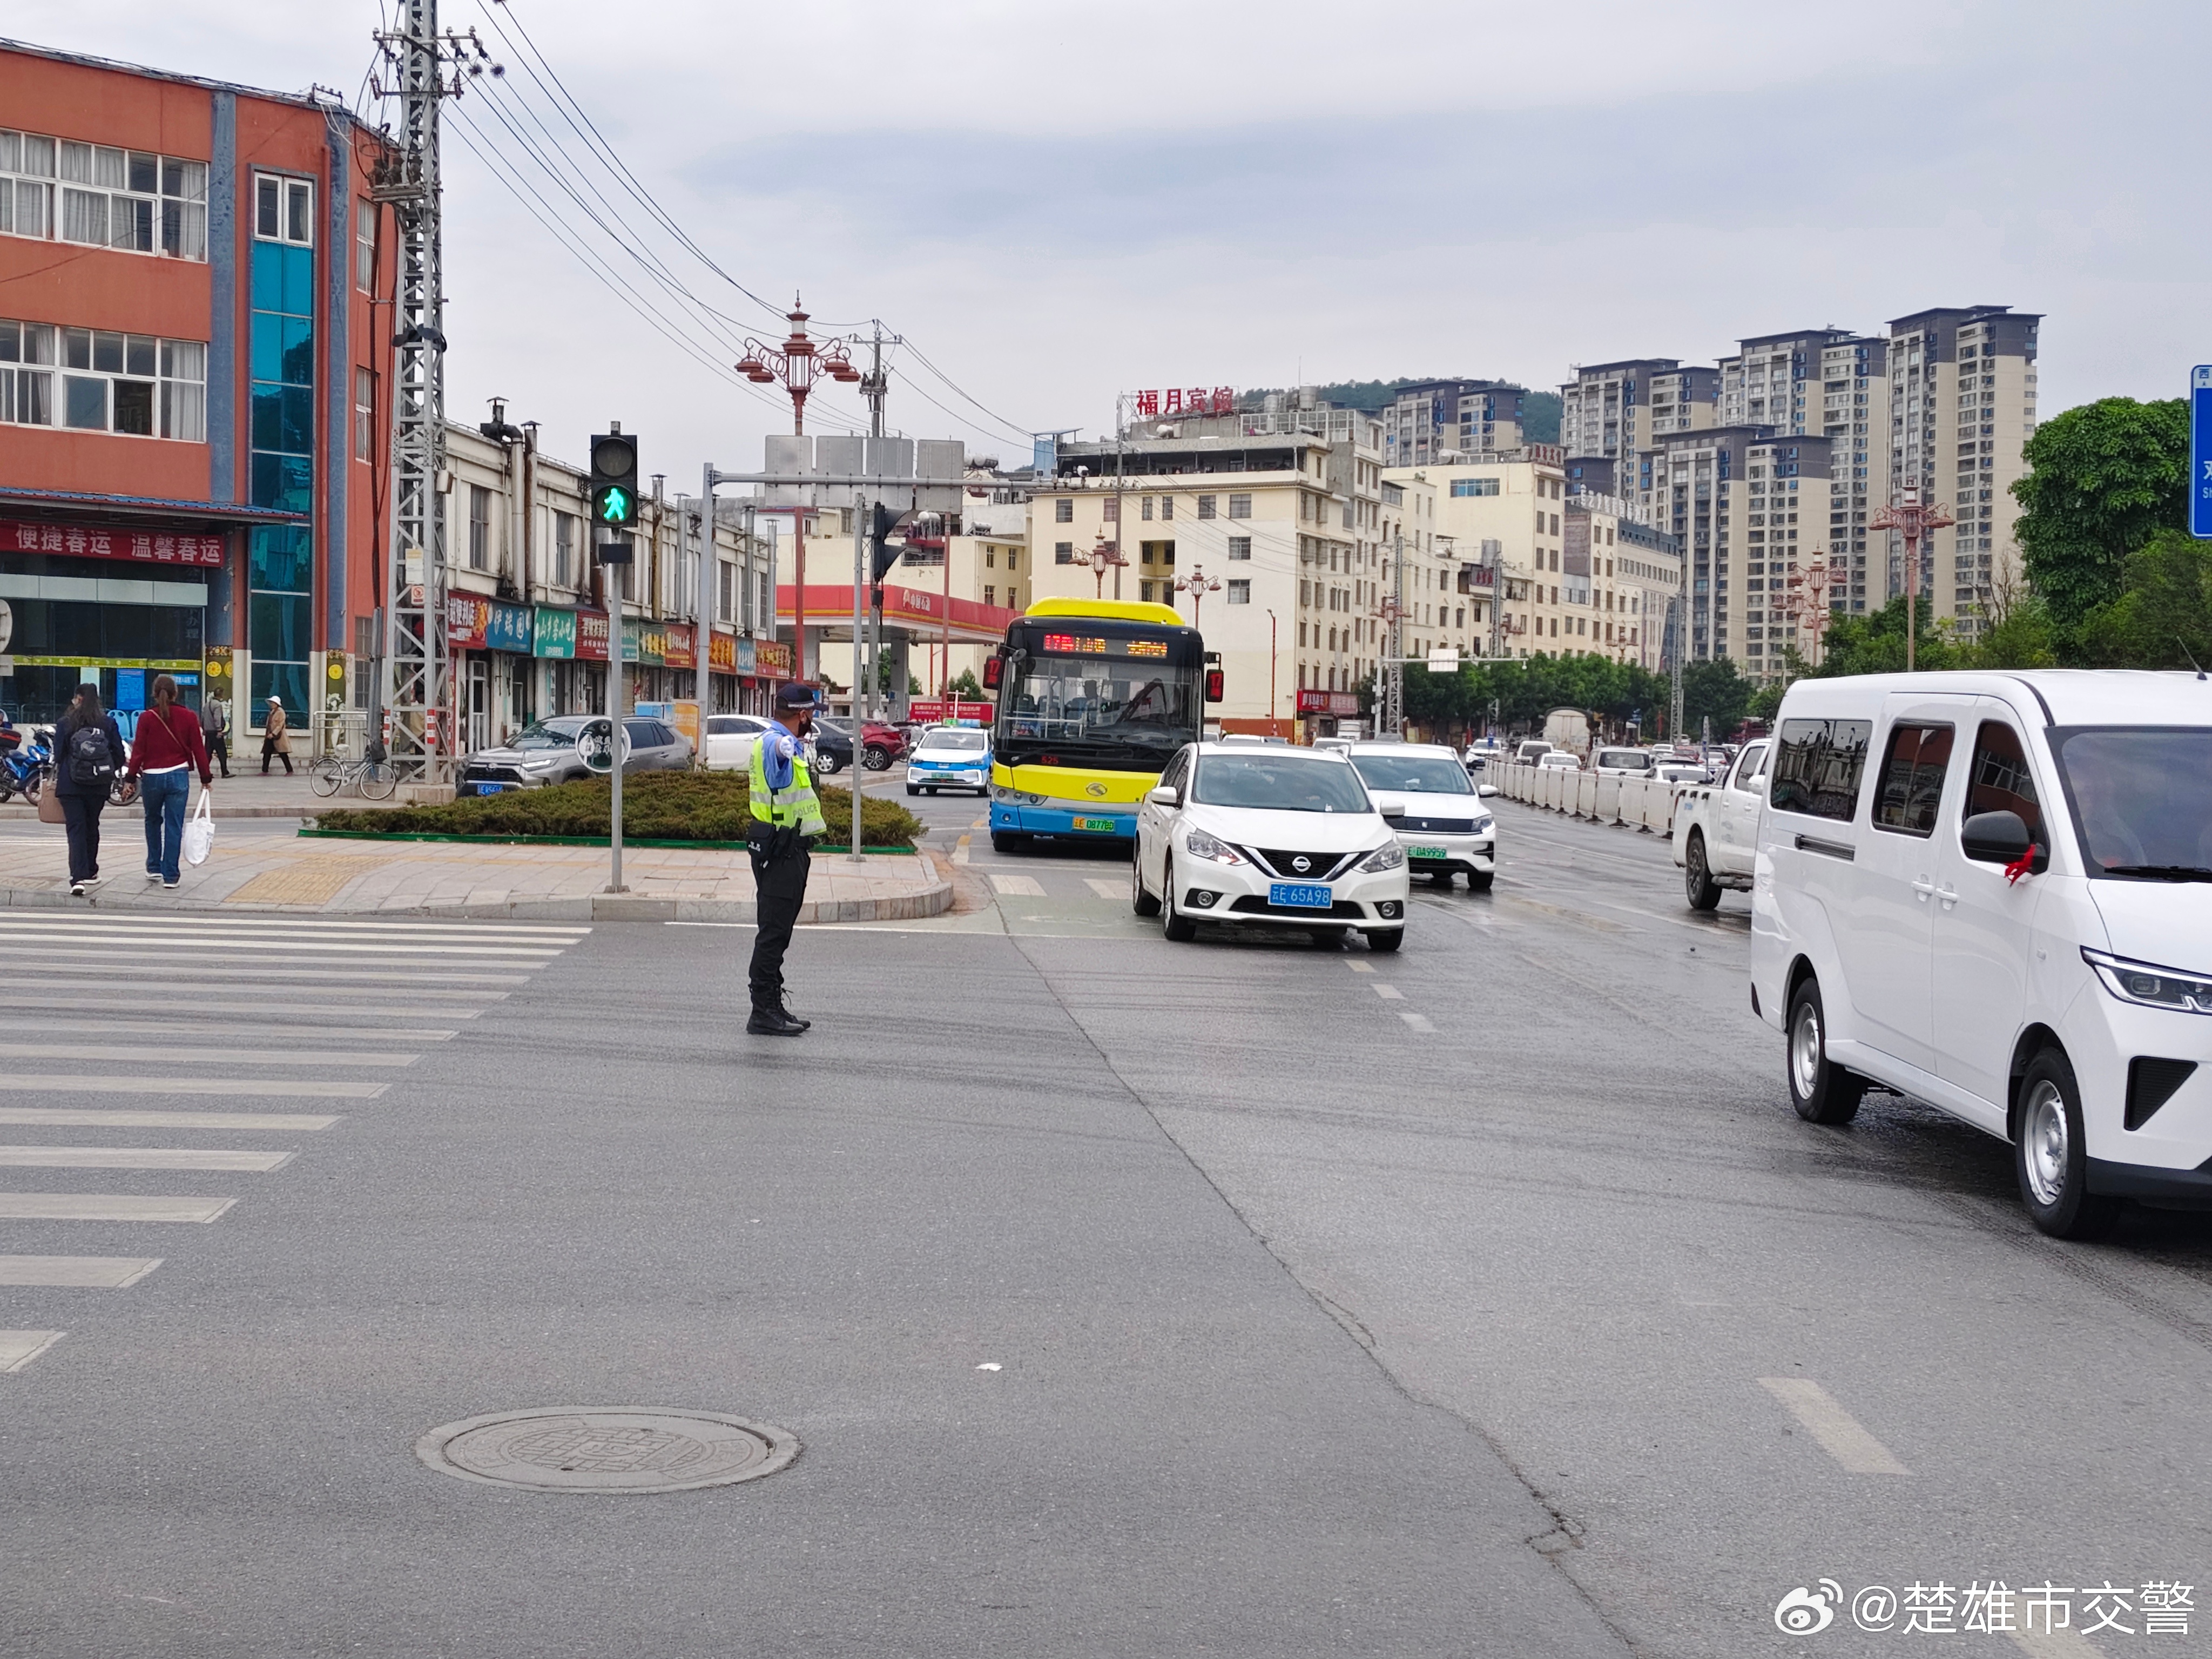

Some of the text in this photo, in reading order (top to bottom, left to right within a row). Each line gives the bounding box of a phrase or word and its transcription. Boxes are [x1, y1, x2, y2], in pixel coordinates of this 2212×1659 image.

[2199, 368, 2209, 379] 西
[1136, 386, 1233, 415] 福月宾馆
[16, 523, 220, 563] 便捷春运 温馨春运
[447, 598, 475, 626] 站便利店
[1041, 756, 1058, 764] 525
[792, 803, 818, 818] POLICE
